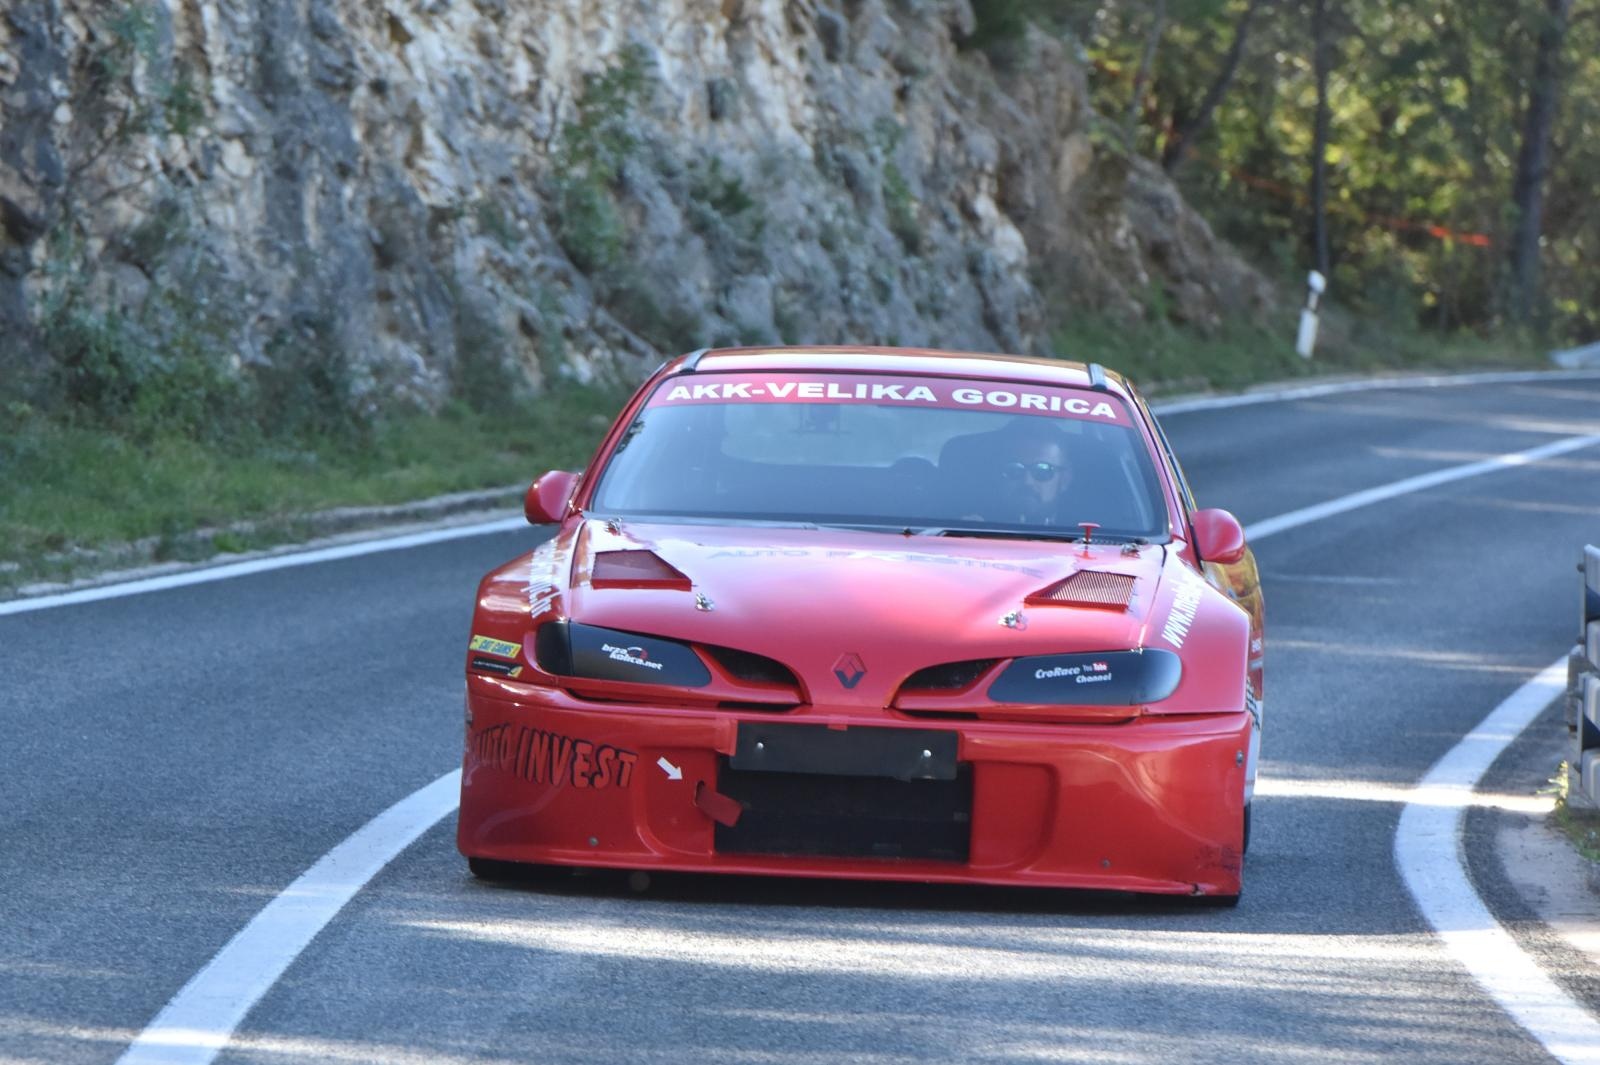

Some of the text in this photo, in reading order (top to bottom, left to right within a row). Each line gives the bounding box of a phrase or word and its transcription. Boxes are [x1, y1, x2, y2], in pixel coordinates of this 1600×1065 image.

[666, 382, 1117, 419] AKK-VELIKA GORICA
[1035, 667, 1080, 679] CroRace
[1076, 672, 1112, 683] Channel
[514, 726, 639, 789] INVEST
